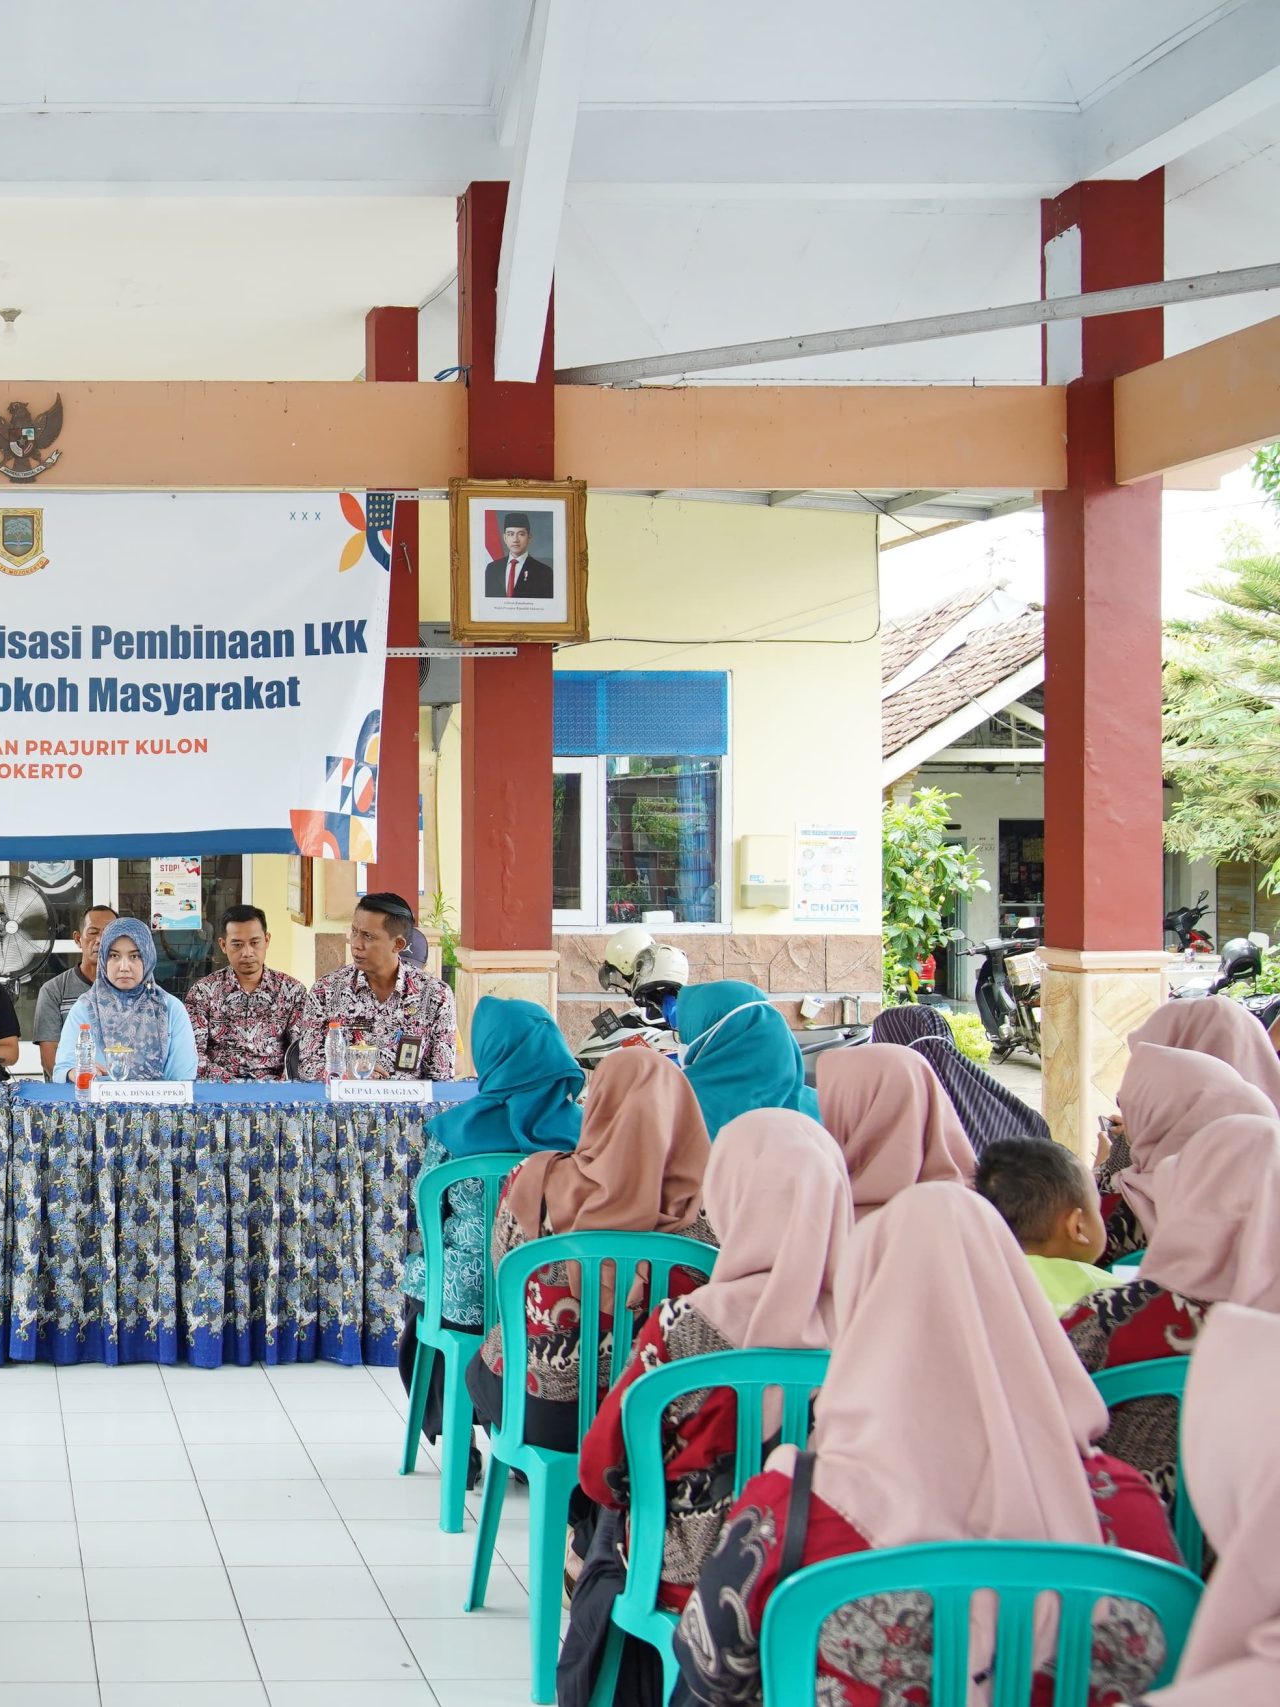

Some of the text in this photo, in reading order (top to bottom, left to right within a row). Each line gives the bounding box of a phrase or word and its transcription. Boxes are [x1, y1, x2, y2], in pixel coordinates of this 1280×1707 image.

[91, 624, 295, 660] Pembinaan
[304, 619, 368, 656] LKK
[88, 675, 301, 716] Masyarakat
[25, 739, 130, 756] PRAJURIT
[135, 738, 209, 755] KULON
[160, 864, 180, 872] STOP!
[344, 1087, 420, 1096] KEPALA BAGIAN
